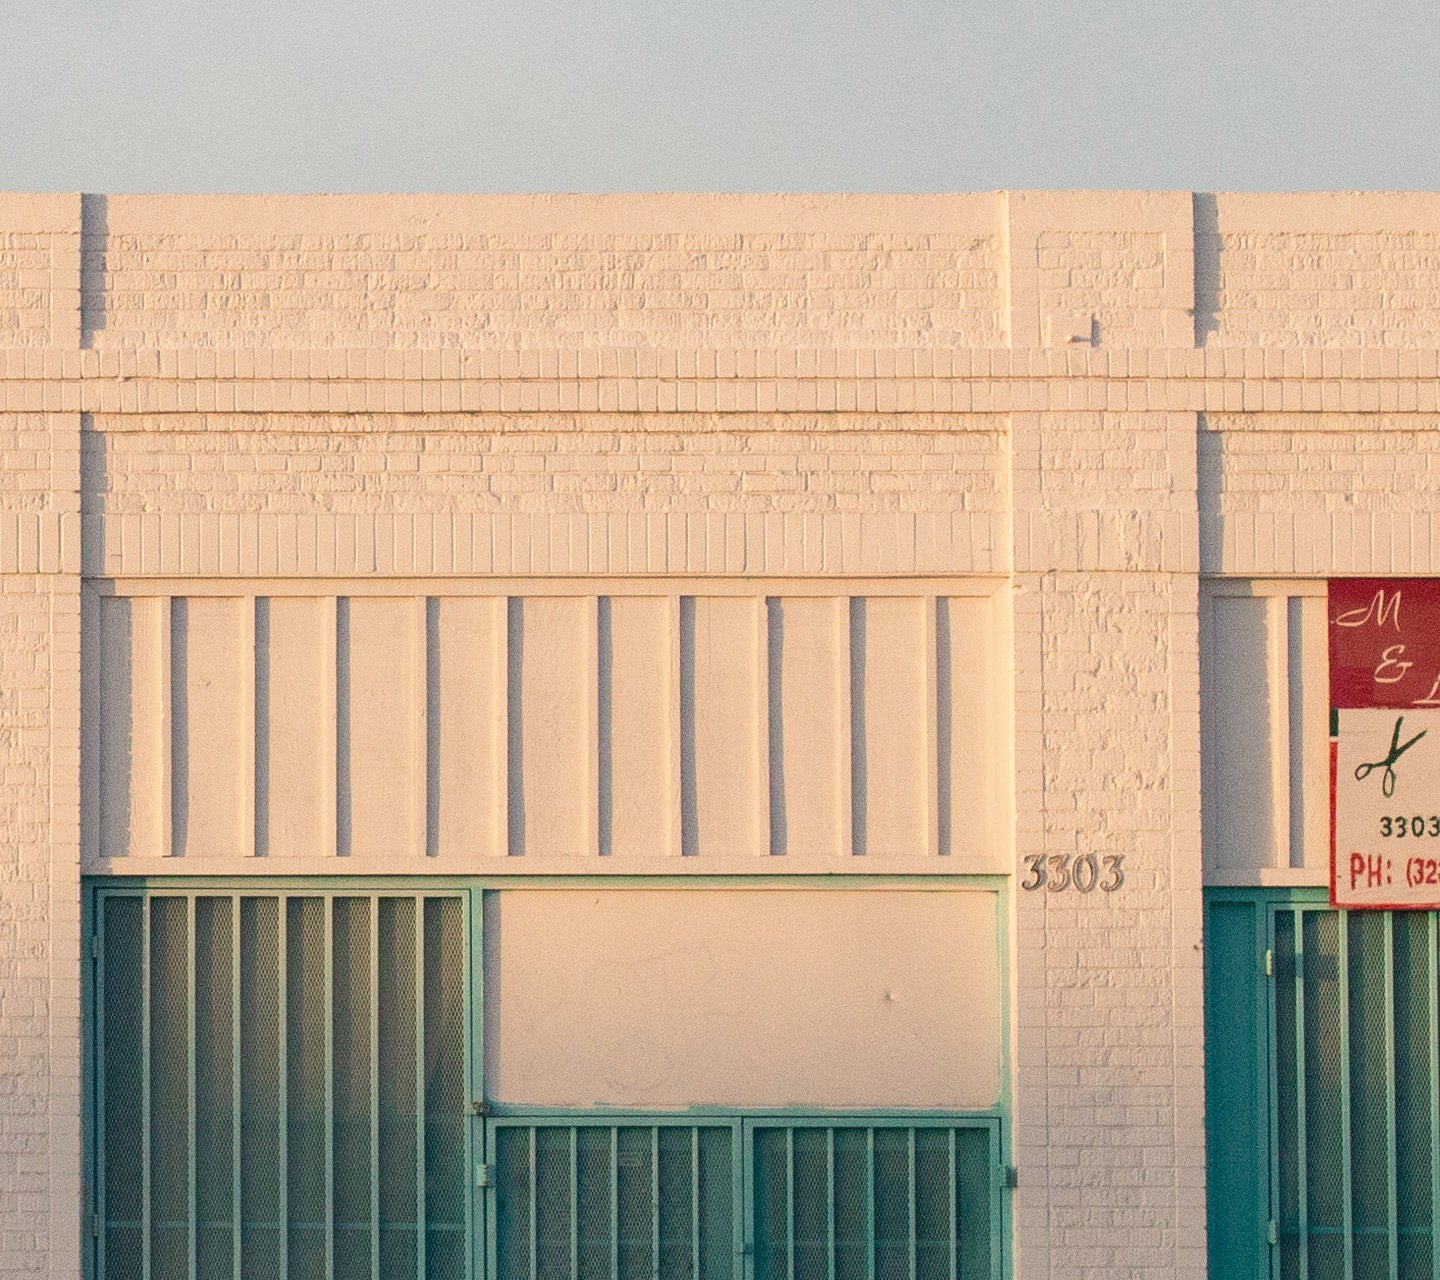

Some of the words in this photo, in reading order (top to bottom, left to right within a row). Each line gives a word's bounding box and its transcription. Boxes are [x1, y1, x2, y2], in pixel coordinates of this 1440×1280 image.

[1336, 589, 1401, 632] M
[1374, 645, 1413, 684] &
[1380, 815, 1440, 838] 3303
[1022, 852, 1125, 893] 3303
[1350, 852, 1392, 890] PH:
